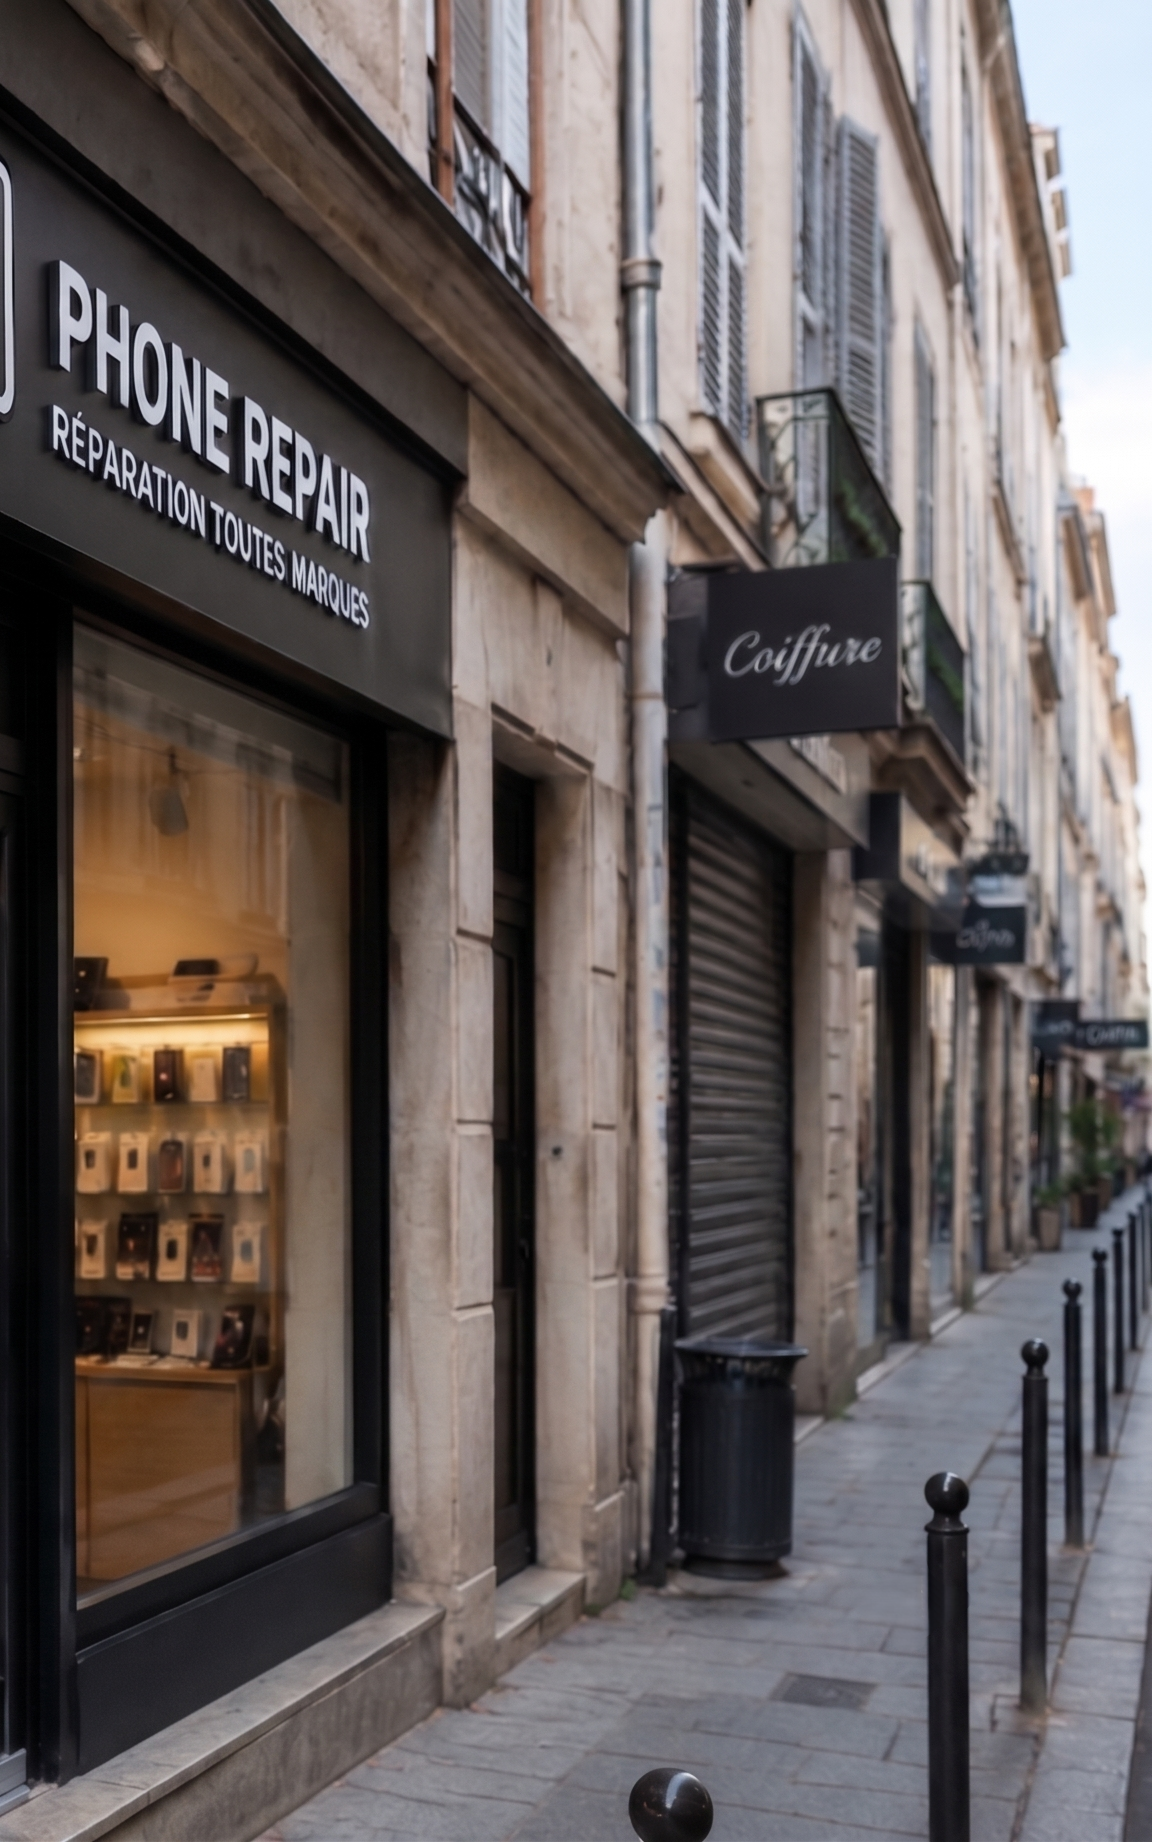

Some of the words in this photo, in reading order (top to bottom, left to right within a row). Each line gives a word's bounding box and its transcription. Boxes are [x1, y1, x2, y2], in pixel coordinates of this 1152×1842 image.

[52, 405, 206, 539] RÉPARATION
[210, 501, 285, 581] TOUTES
[292, 550, 371, 629] MARQUES
[58, 260, 231, 474] PHONE
[244, 396, 371, 564] REPAIR
[724, 622, 882, 687] Coiffure
